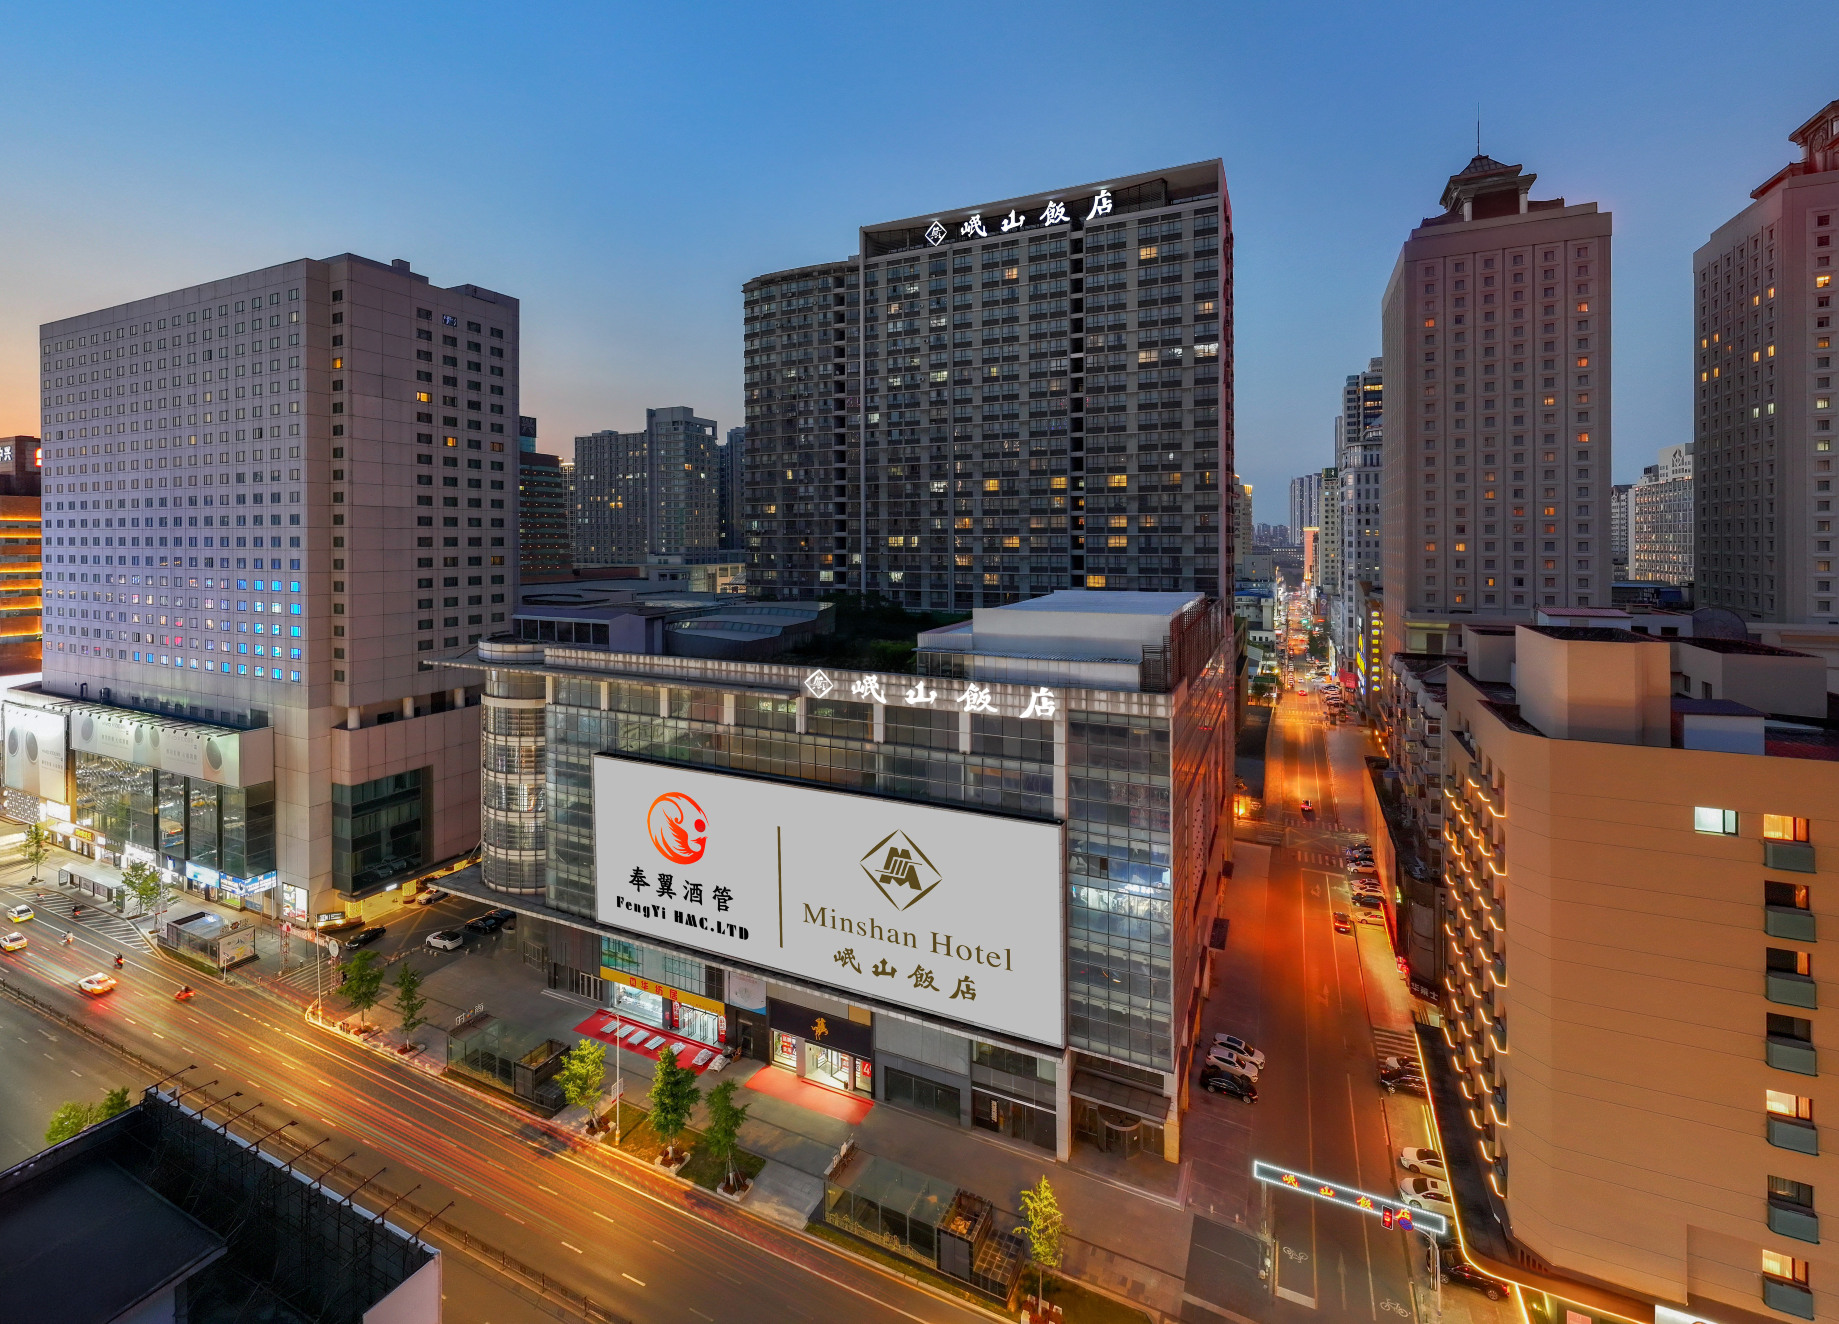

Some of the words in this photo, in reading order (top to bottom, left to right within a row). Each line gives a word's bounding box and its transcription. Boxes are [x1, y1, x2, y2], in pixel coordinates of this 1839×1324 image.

[629, 866, 733, 912] 奉翼酒管
[616, 895, 666, 919] FengYi
[674, 910, 750, 941] HMC.LTD
[802, 902, 918, 949] Minshan
[930, 931, 1014, 973] Hotel
